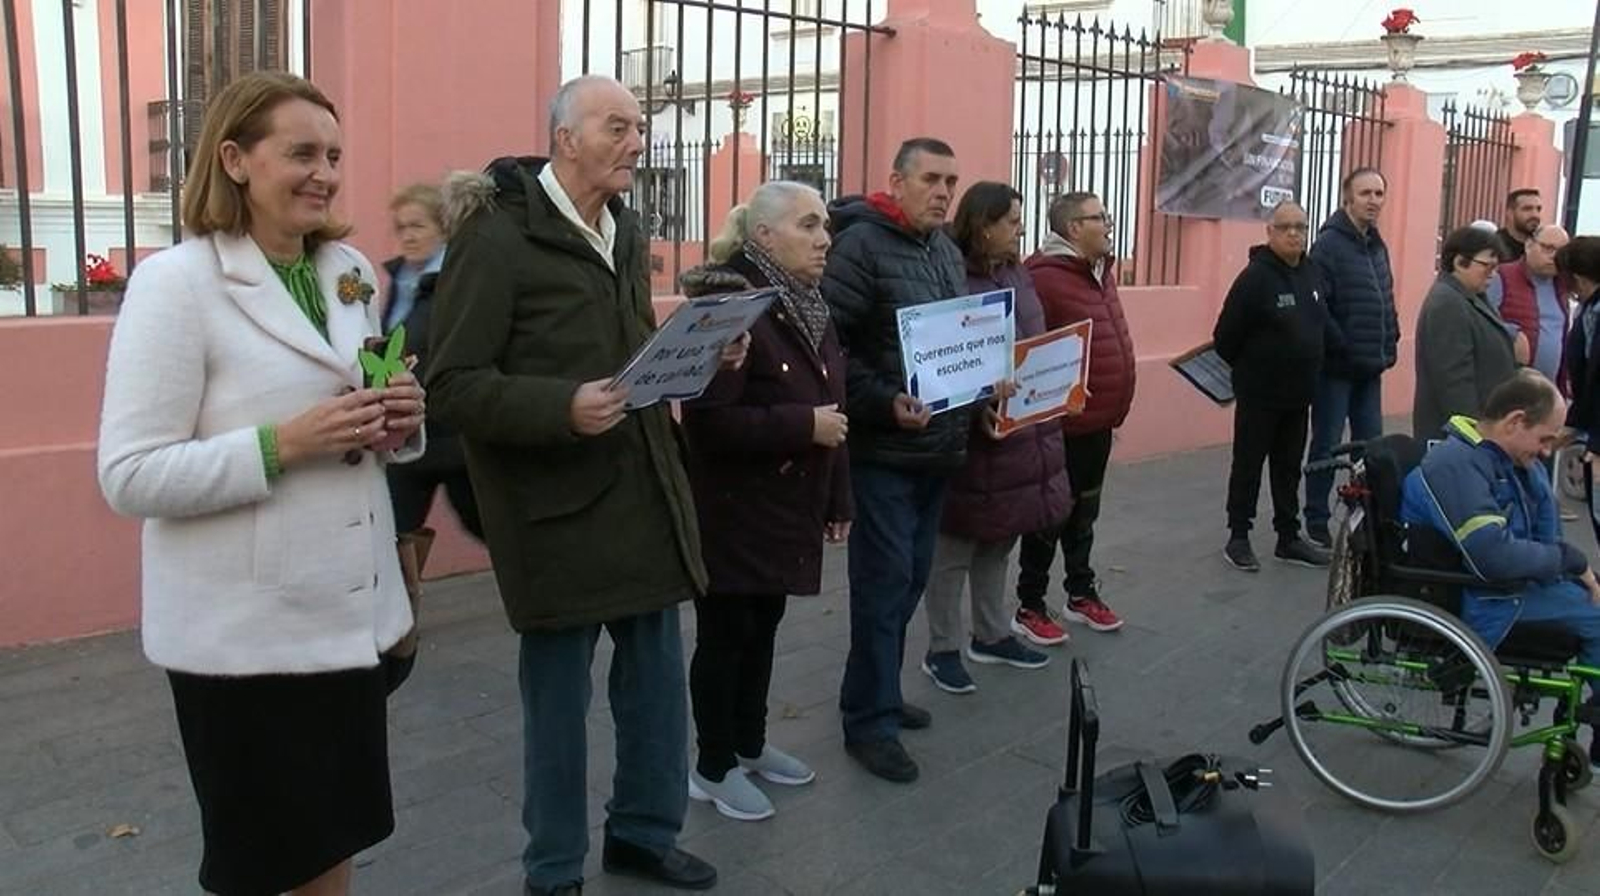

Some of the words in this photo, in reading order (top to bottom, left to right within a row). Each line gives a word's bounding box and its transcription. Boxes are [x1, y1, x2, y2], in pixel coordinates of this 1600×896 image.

[913, 342, 965, 365] Queremos
[966, 338, 985, 352] que
[987, 333, 1006, 346] nos
